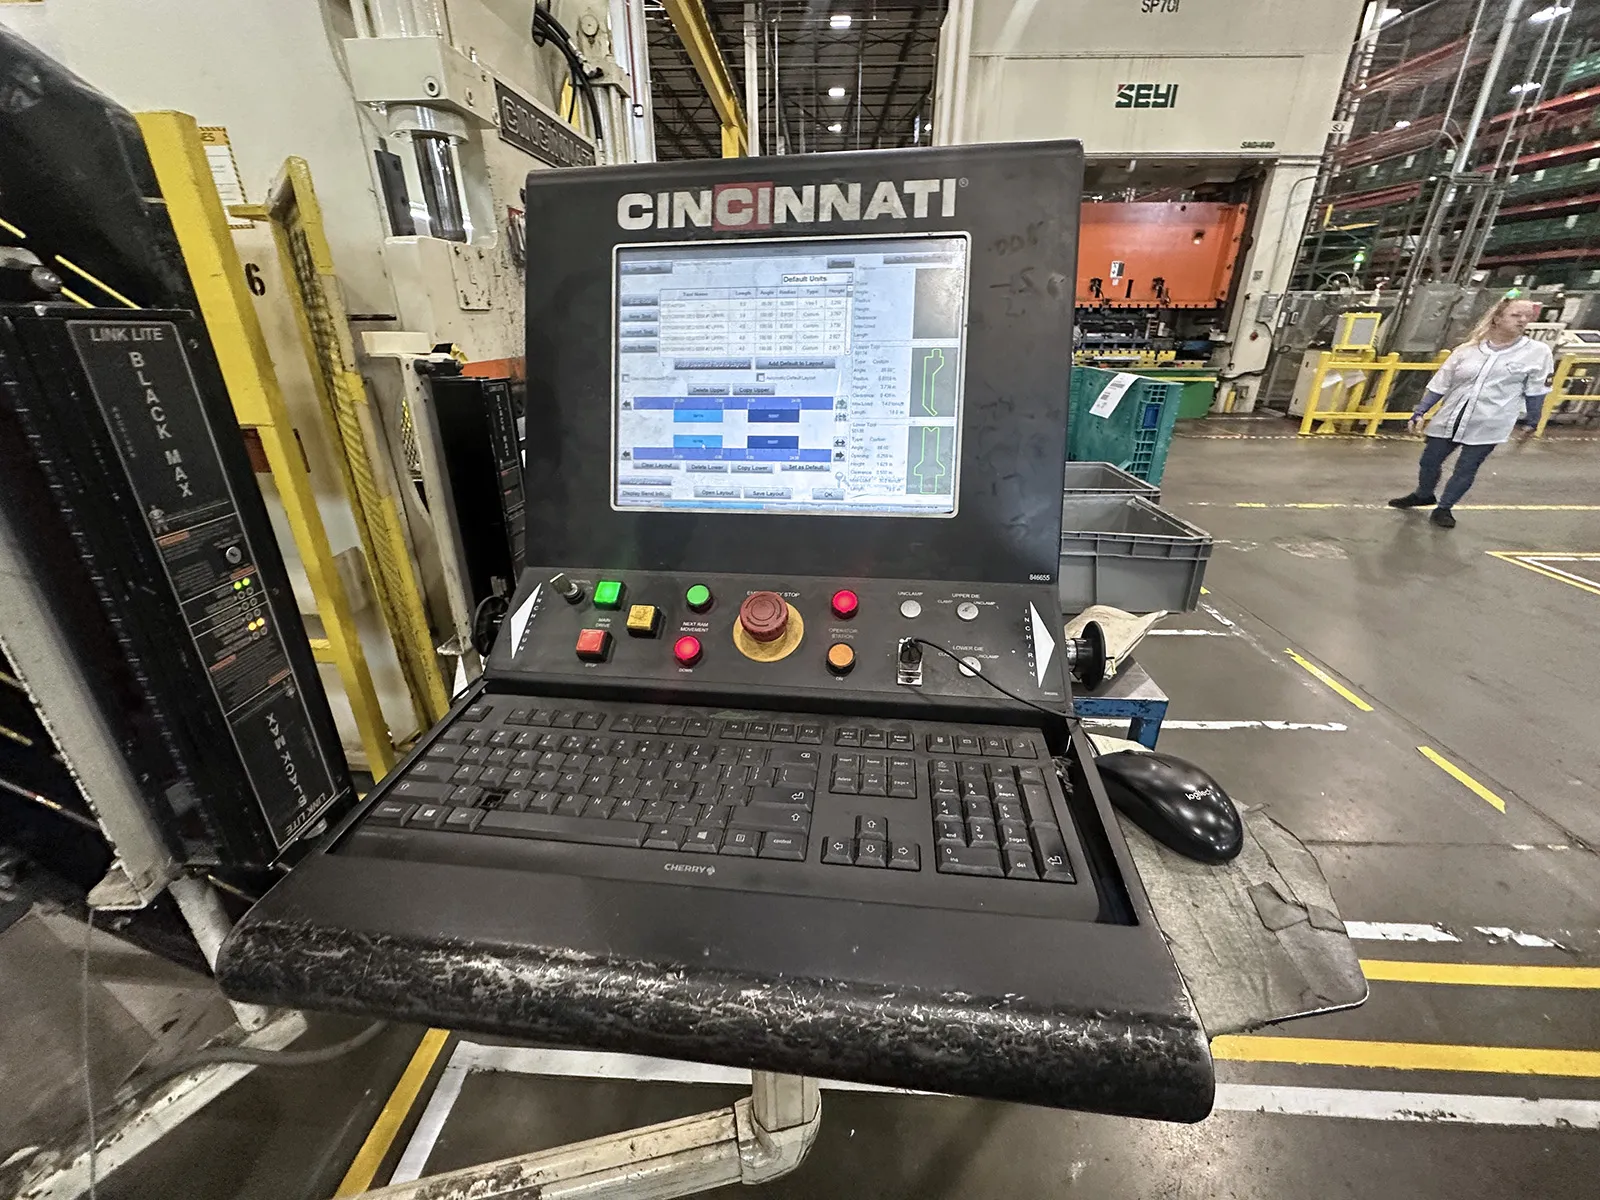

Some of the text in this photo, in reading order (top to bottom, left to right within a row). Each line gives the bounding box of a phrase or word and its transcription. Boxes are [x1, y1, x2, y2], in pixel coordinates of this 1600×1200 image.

[1115, 84, 1179, 108] SEYI
[617, 178, 956, 230] CINCINNATI
[245, 262, 265, 296] 6
[90, 327, 165, 342] LINK LITE
[128, 351, 193, 498] BLACK MAX
[1024, 608, 1037, 677] INCH/RUN
[664, 863, 706, 874] CHERRY
